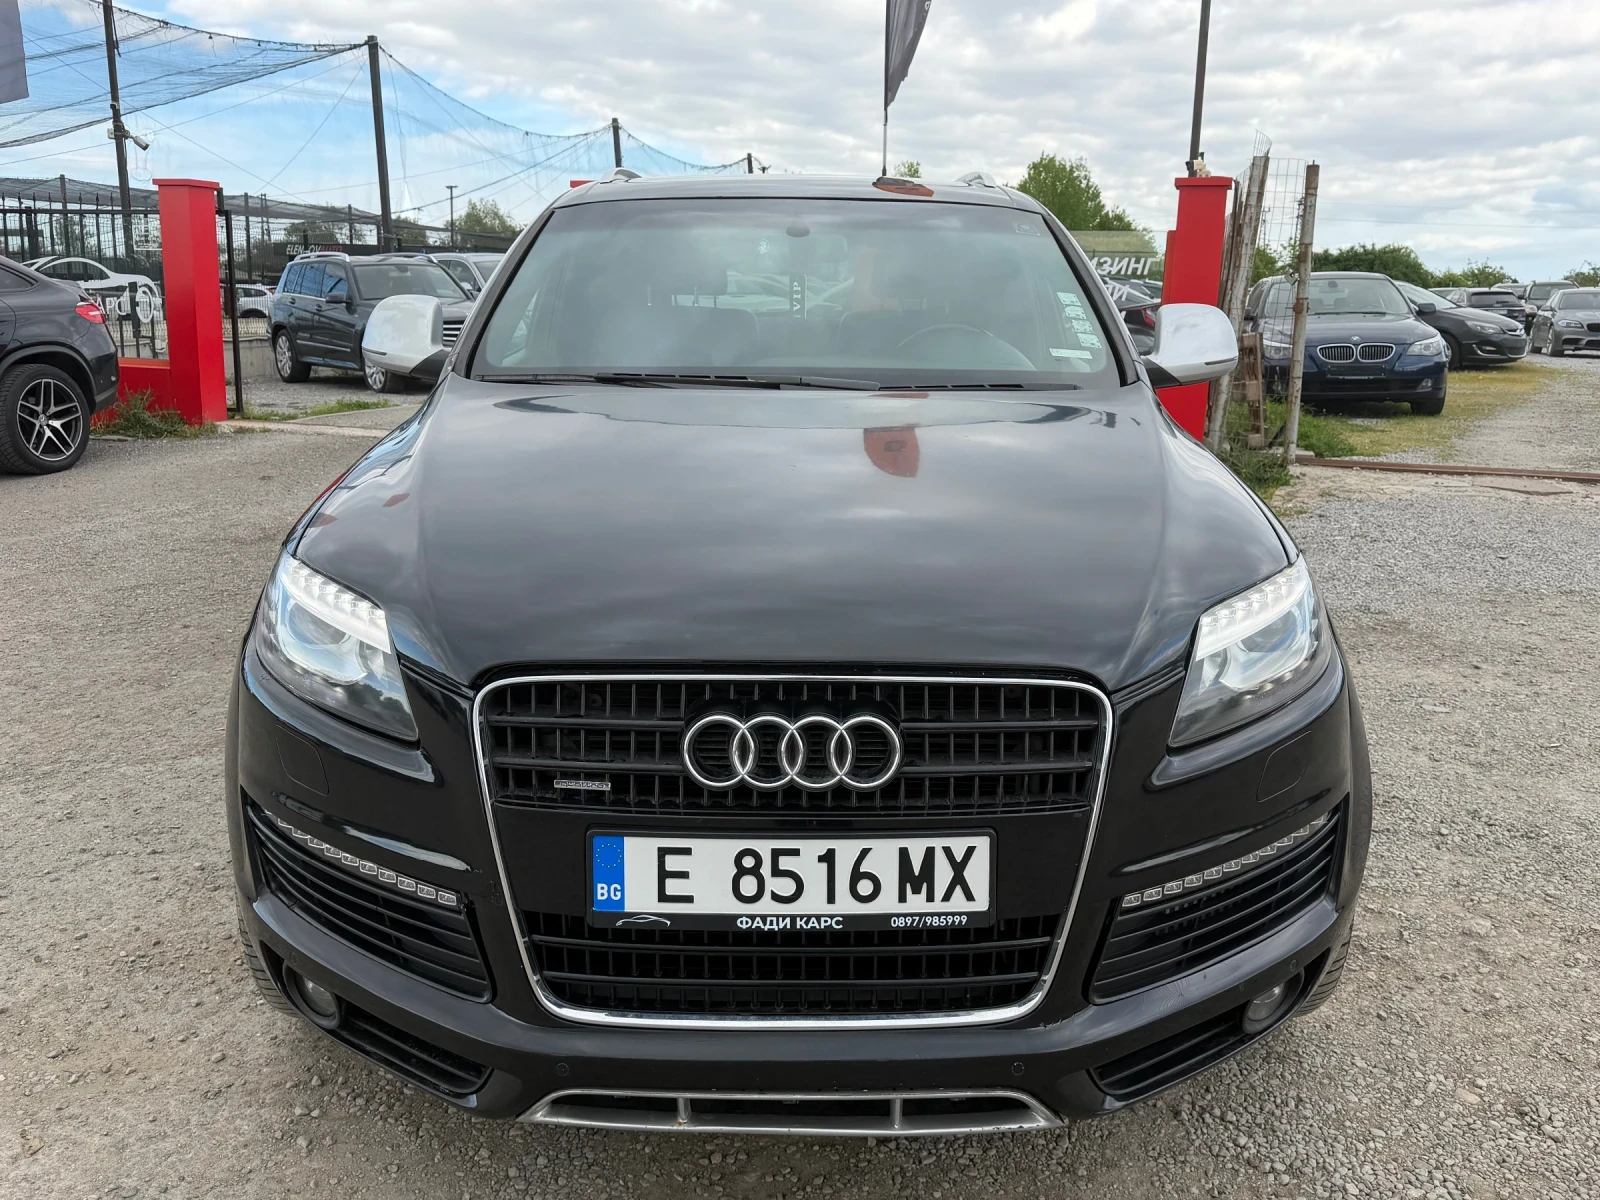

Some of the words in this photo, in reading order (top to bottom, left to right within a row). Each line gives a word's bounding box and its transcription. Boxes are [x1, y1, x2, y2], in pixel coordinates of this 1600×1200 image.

[657, 846, 695, 903] E
[731, 847, 882, 904] 8516
[898, 845, 977, 903] MX
[597, 883, 622, 900] BG
[736, 916, 791, 931] ФАДИ
[796, 916, 844, 930] КАРС
[890, 915, 968, 928] 0897/985999
